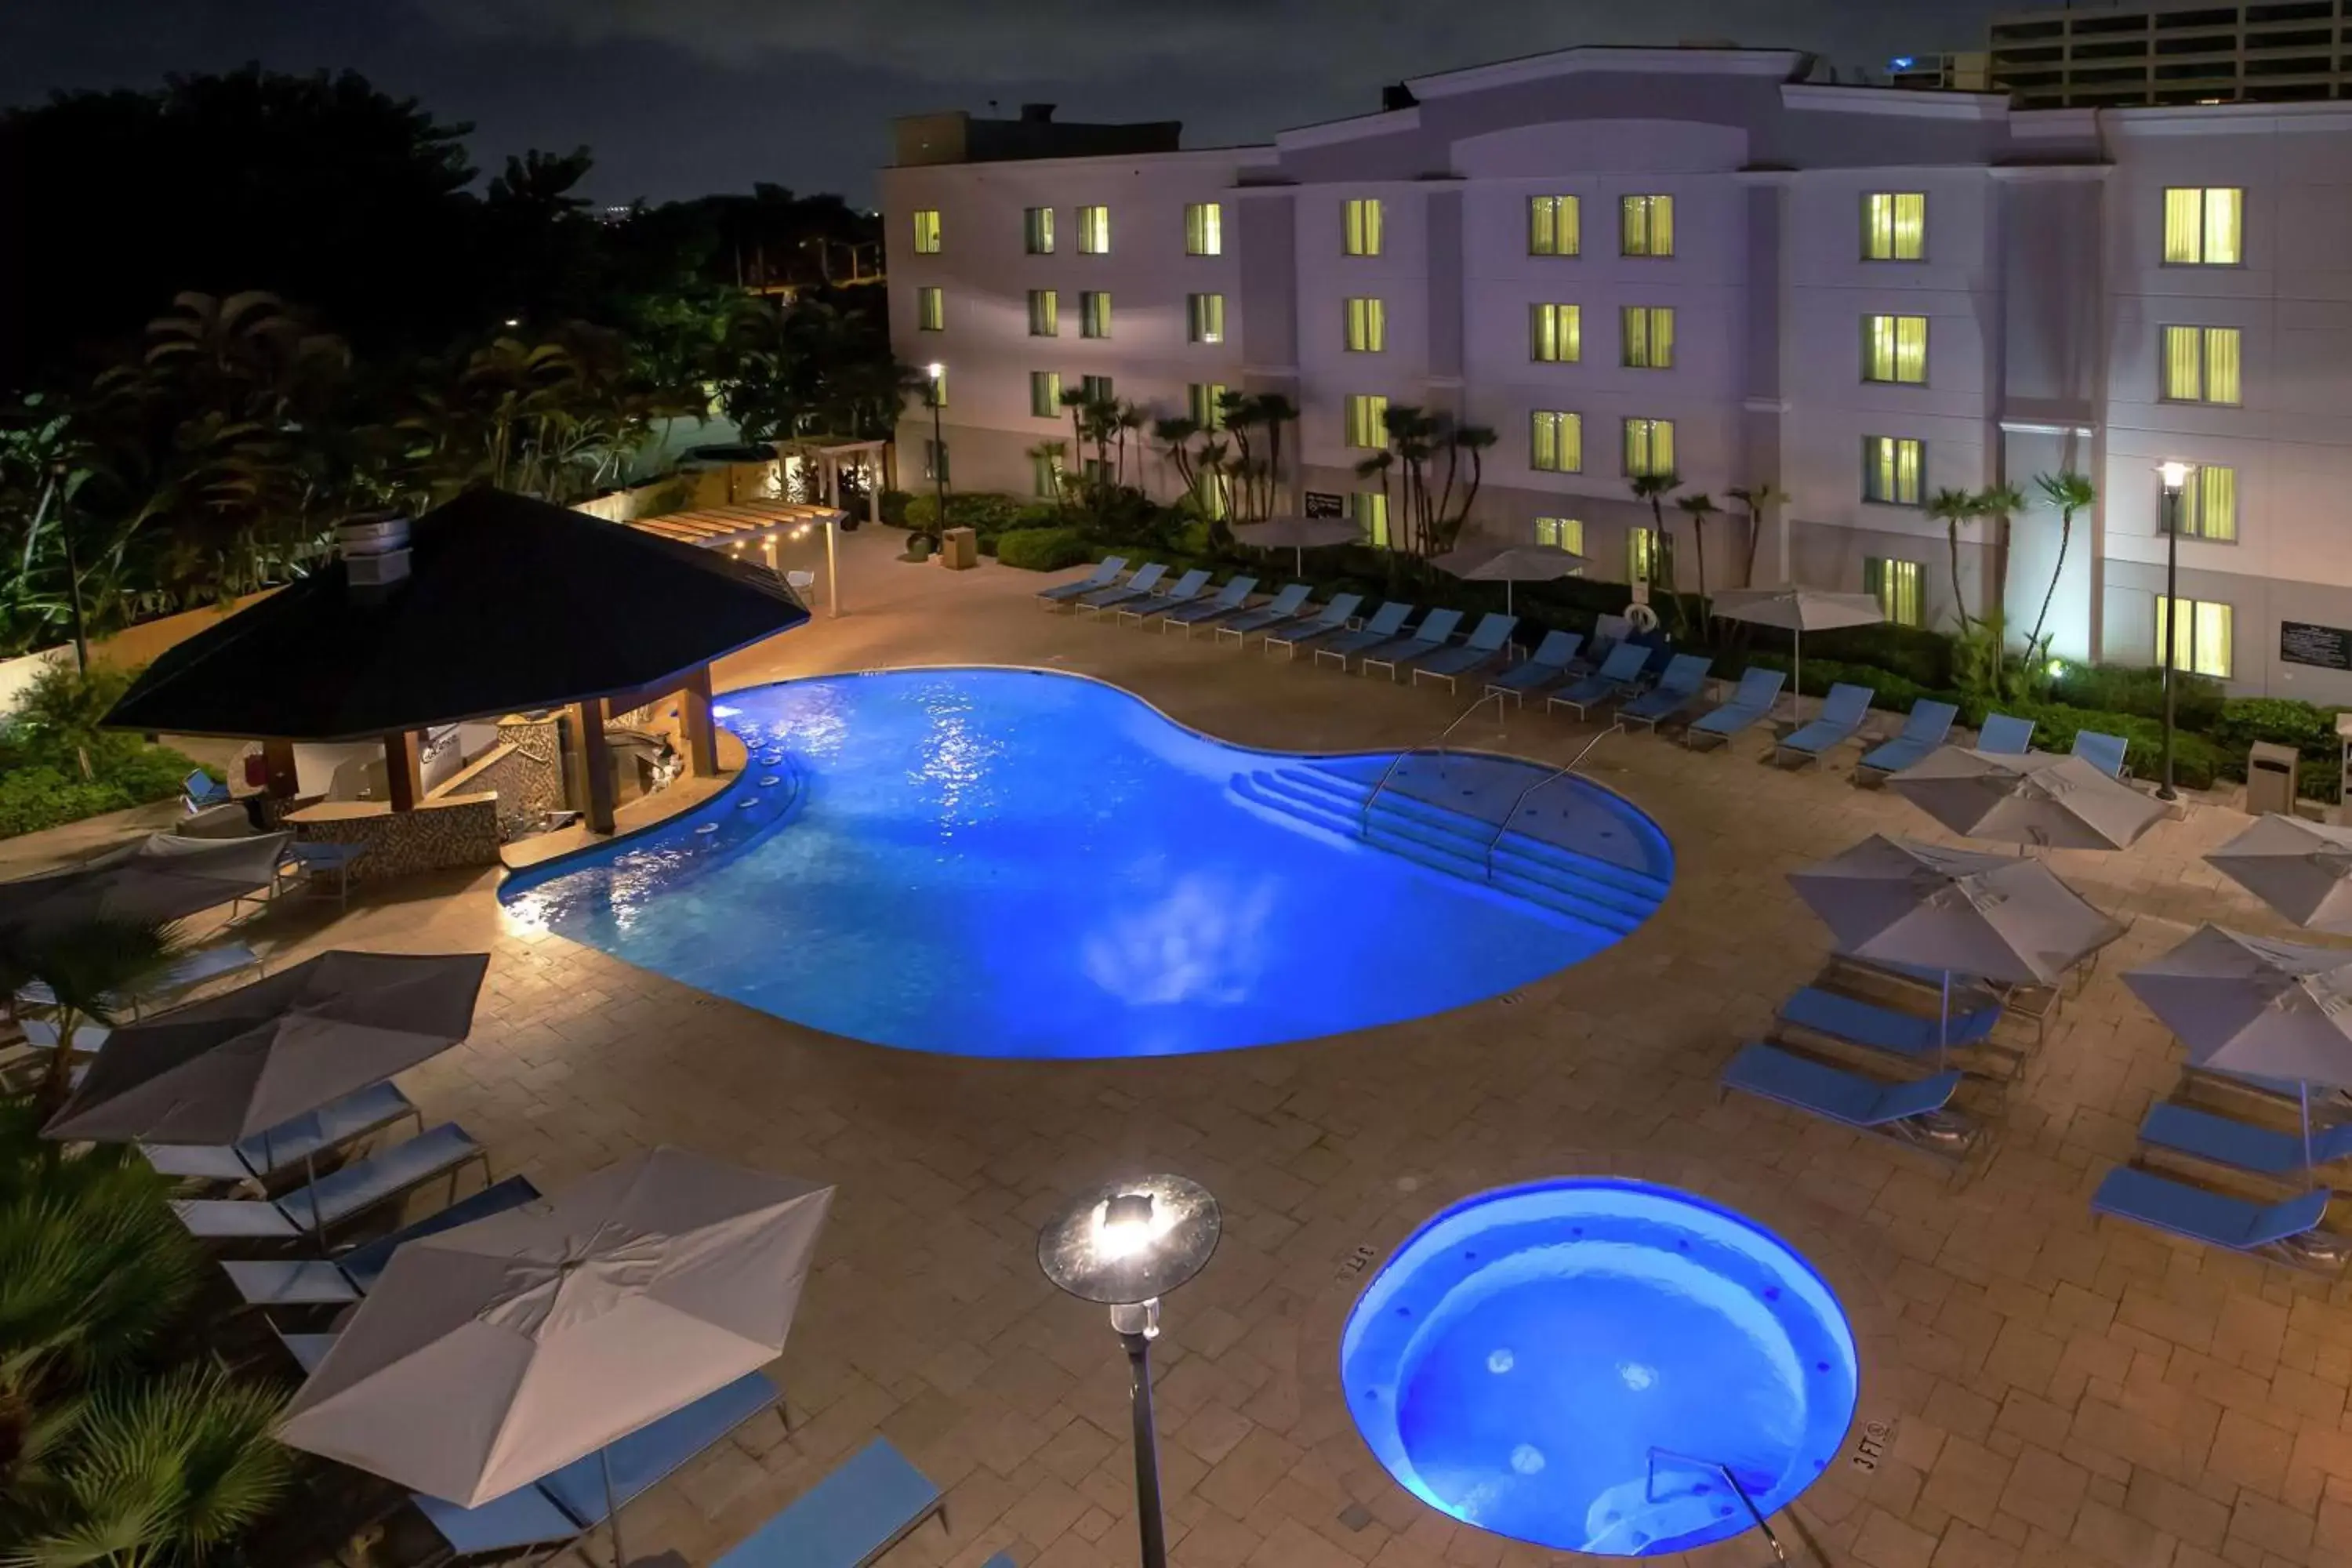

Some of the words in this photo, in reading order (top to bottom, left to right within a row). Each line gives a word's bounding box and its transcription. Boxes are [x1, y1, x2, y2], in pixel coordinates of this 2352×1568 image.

[1346, 1255, 1367, 1272] FT
[1858, 1436, 1882, 1457] FT
[1853, 1457, 1875, 1469] 3
